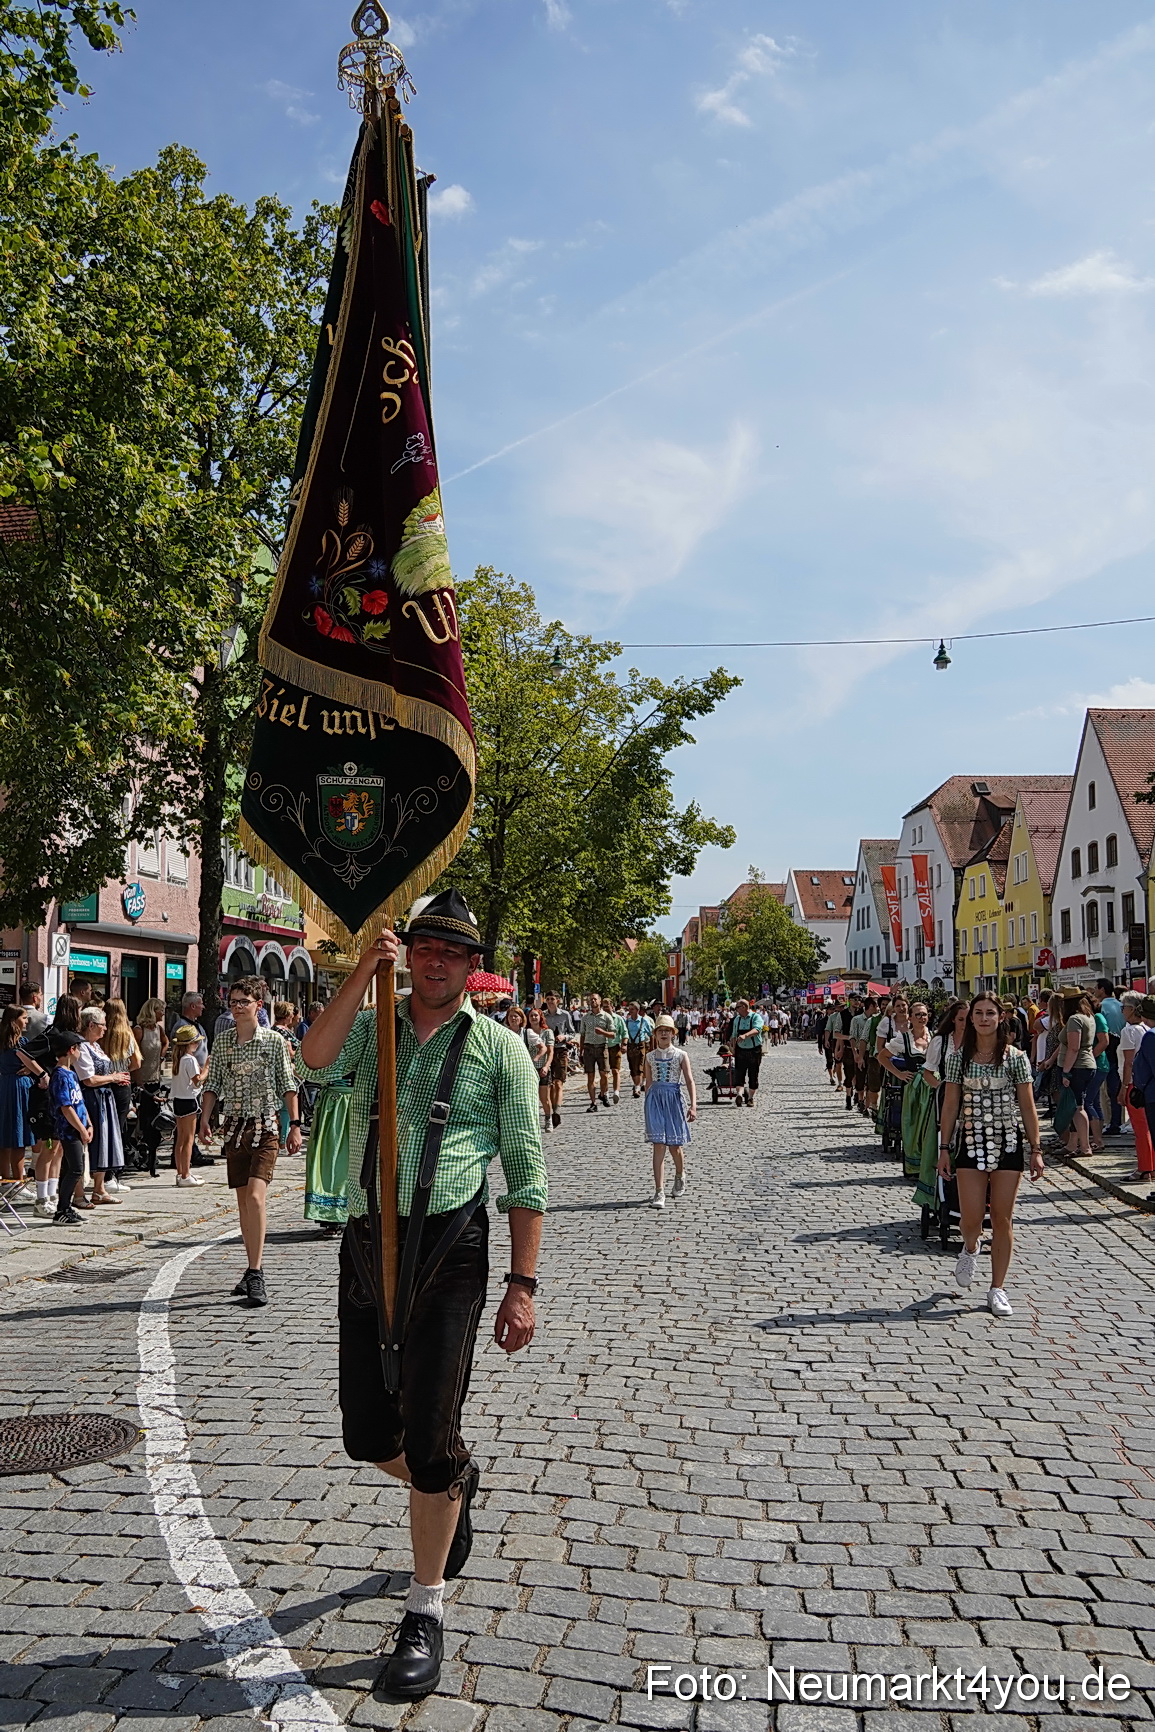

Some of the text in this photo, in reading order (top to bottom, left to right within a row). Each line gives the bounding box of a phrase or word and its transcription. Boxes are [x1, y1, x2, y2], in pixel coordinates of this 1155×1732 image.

[256, 677, 313, 731] Ziel
[127, 894, 146, 914] FASS
[916, 880, 932, 917] SALE
